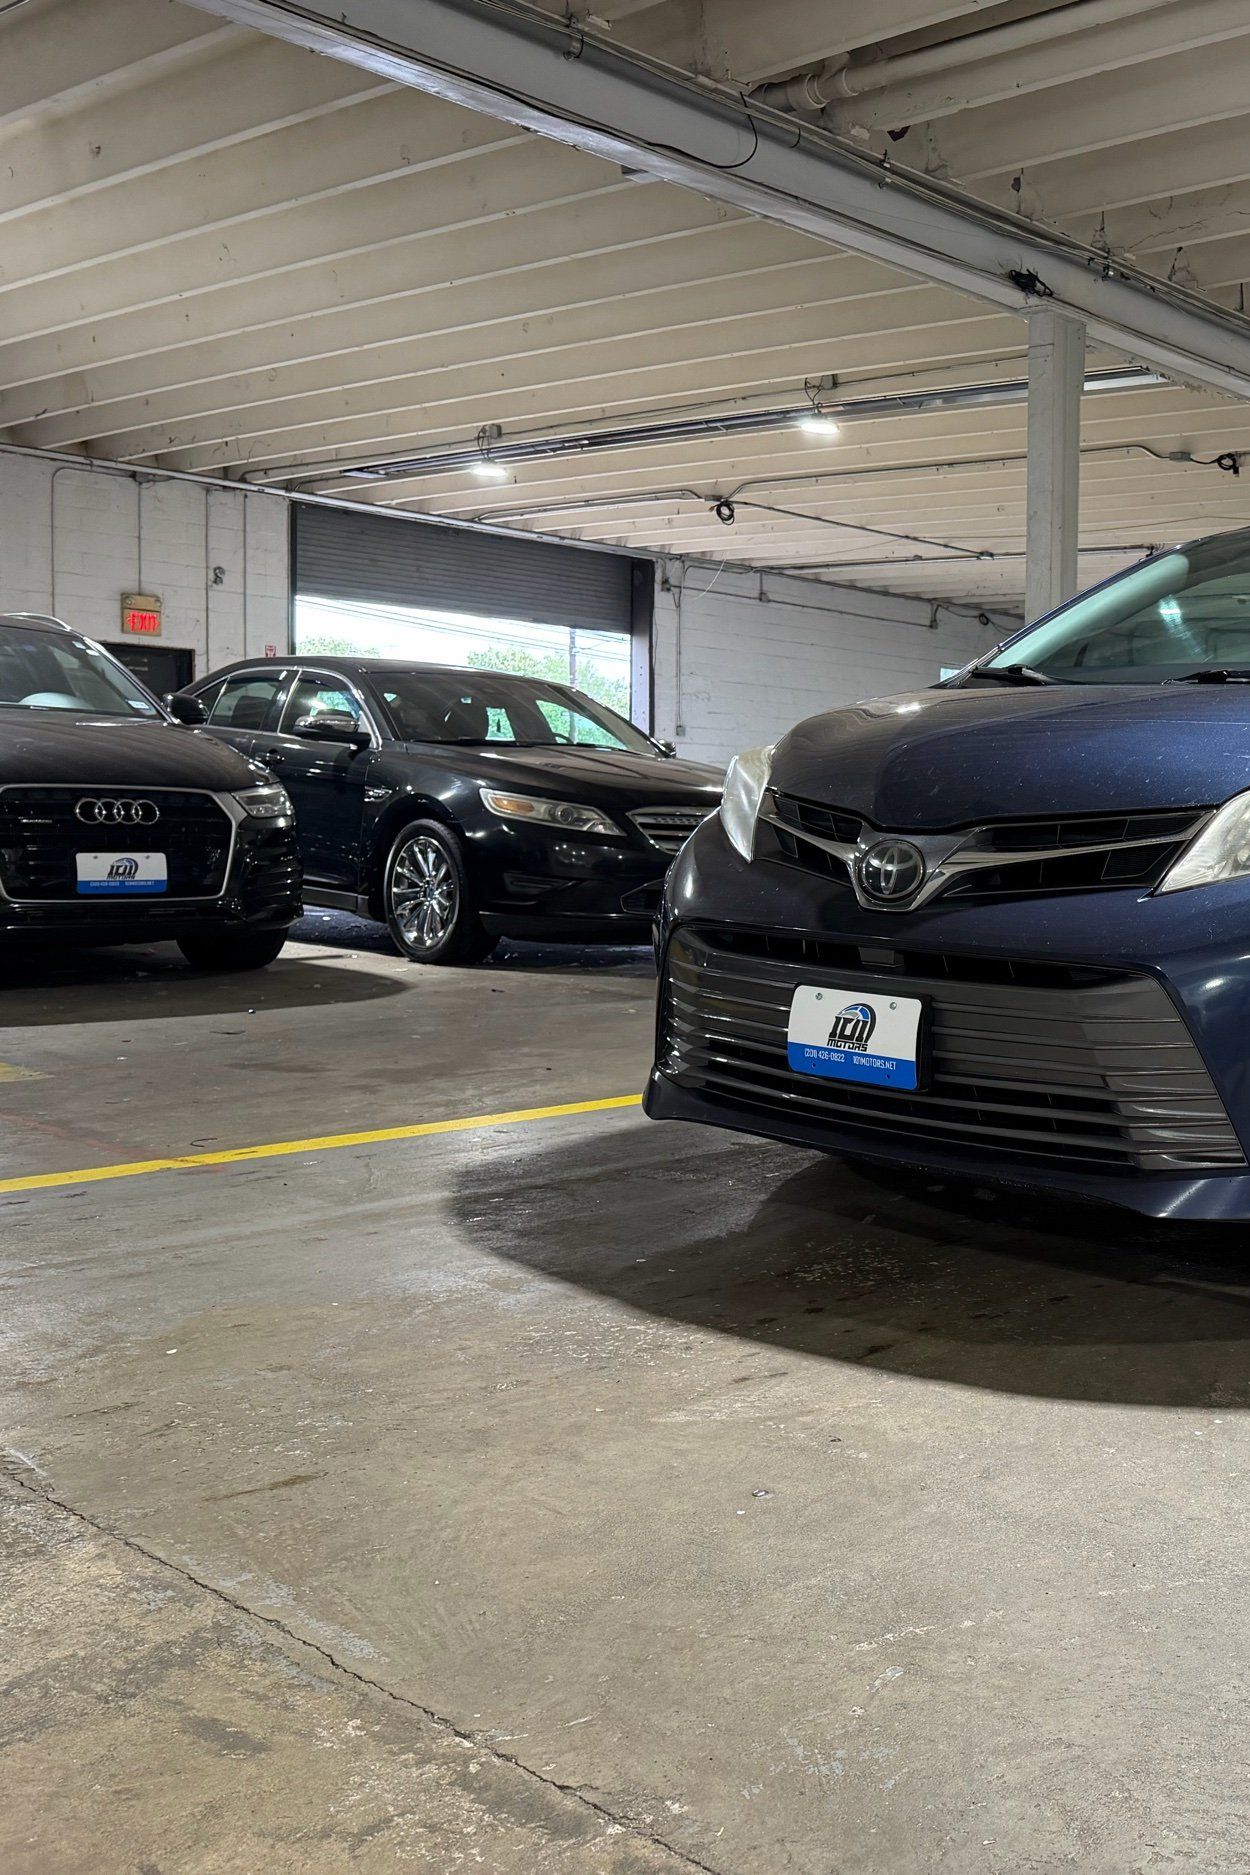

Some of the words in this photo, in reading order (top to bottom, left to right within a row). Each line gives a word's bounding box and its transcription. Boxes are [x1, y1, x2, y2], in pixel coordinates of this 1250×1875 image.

[130, 611, 156, 632] EXIT
[829, 1016, 870, 1043] 101
[826, 1039, 869, 1052] MOTORS
[804, 1048, 817, 1059] (201)
[818, 1050, 845, 1063] 426-0822
[853, 1055, 897, 1070] 101MOTORS.NET
